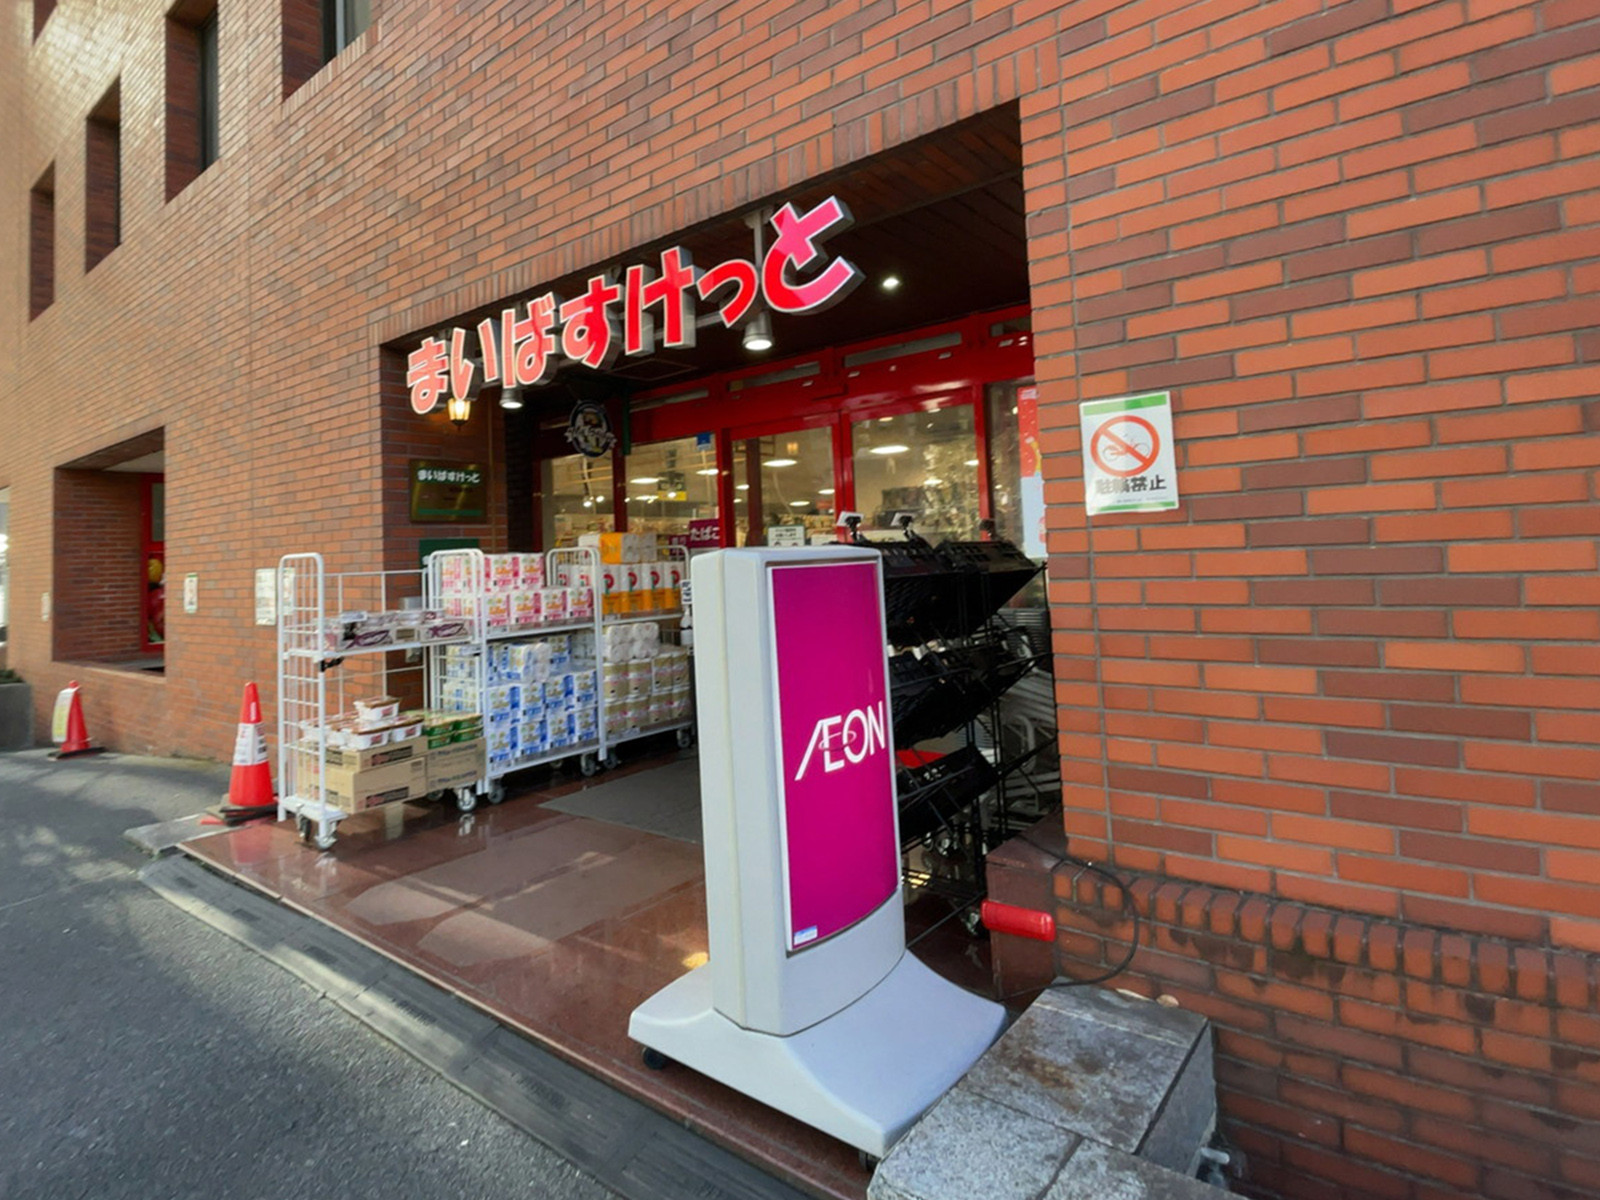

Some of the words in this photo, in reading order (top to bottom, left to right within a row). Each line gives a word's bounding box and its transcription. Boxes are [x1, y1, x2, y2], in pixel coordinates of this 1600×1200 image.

[406, 195, 856, 415] まいばすけっと
